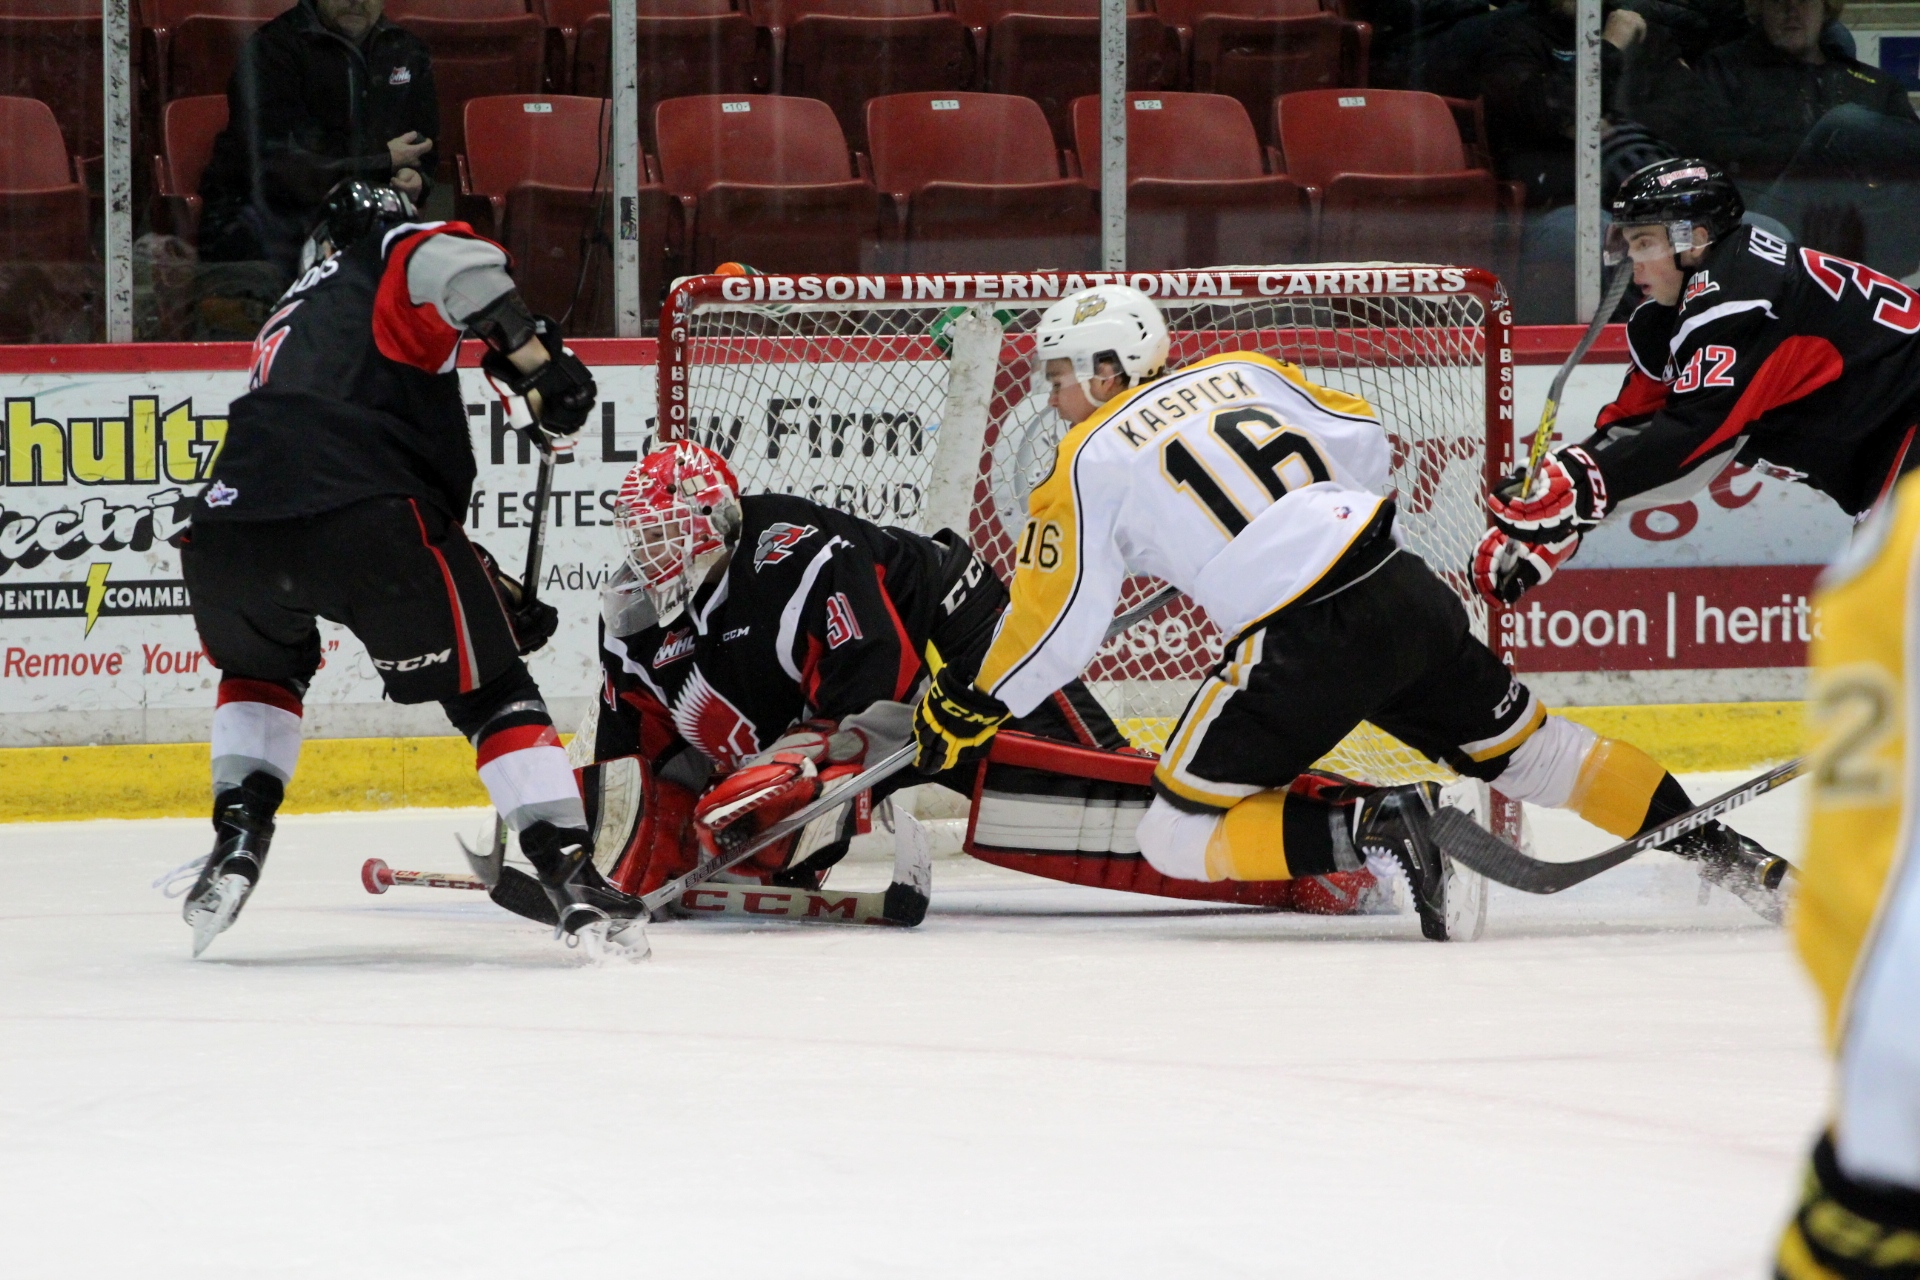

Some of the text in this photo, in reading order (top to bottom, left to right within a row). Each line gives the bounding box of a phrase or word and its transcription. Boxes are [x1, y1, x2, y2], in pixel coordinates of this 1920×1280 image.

[721, 275, 886, 301] GIBSON
[1257, 268, 1467, 296] CARRIERS
[670, 326, 687, 441] GIBSON
[1498, 309, 1513, 420] GIBSON
[1673, 344, 1737, 394] 32
[766, 396, 923, 459] Firm
[1117, 367, 1258, 450] KASPICK
[0, 394, 229, 487] hultz
[1158, 405, 1337, 543] 16
[0, 487, 192, 576] ectri
[1015, 517, 1063, 574] 16
[0, 587, 84, 611] ENTIAL
[940, 553, 985, 616] CC
[657, 634, 696, 661] WHL
[722, 625, 751, 642] CCM
[826, 591, 864, 650] 31
[4, 646, 123, 678] Remove
[372, 648, 452, 672] CCM
[680, 888, 858, 919] CCM
